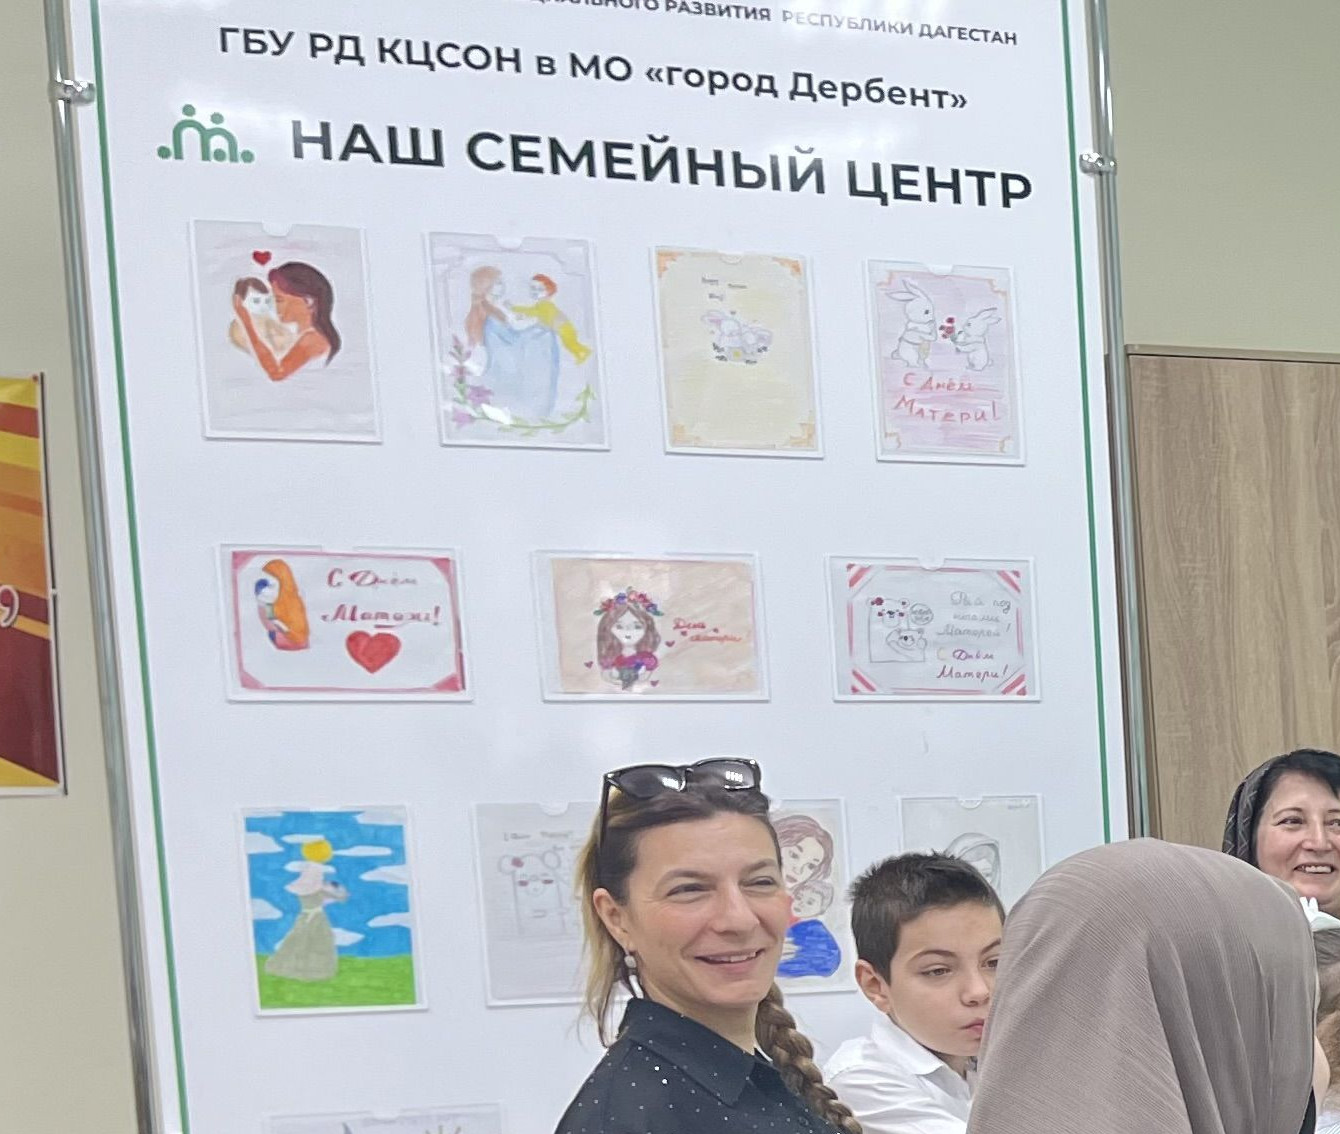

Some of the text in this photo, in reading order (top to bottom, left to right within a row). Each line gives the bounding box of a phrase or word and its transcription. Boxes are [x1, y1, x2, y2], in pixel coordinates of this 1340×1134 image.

[665, 0, 771, 21] РАЗВИТИЯ
[782, 10, 913, 35] РЕСПУБЛИКИ
[919, 24, 1018, 45] ДАГЕСТАН
[219, 26, 968, 110] ГБУ РД КЦСОН в МО «город Дербент»
[291, 119, 1033, 209] НАШ СЕМЕЙНЫЙ ЦЕНТР
[327, 567, 343, 587] С
